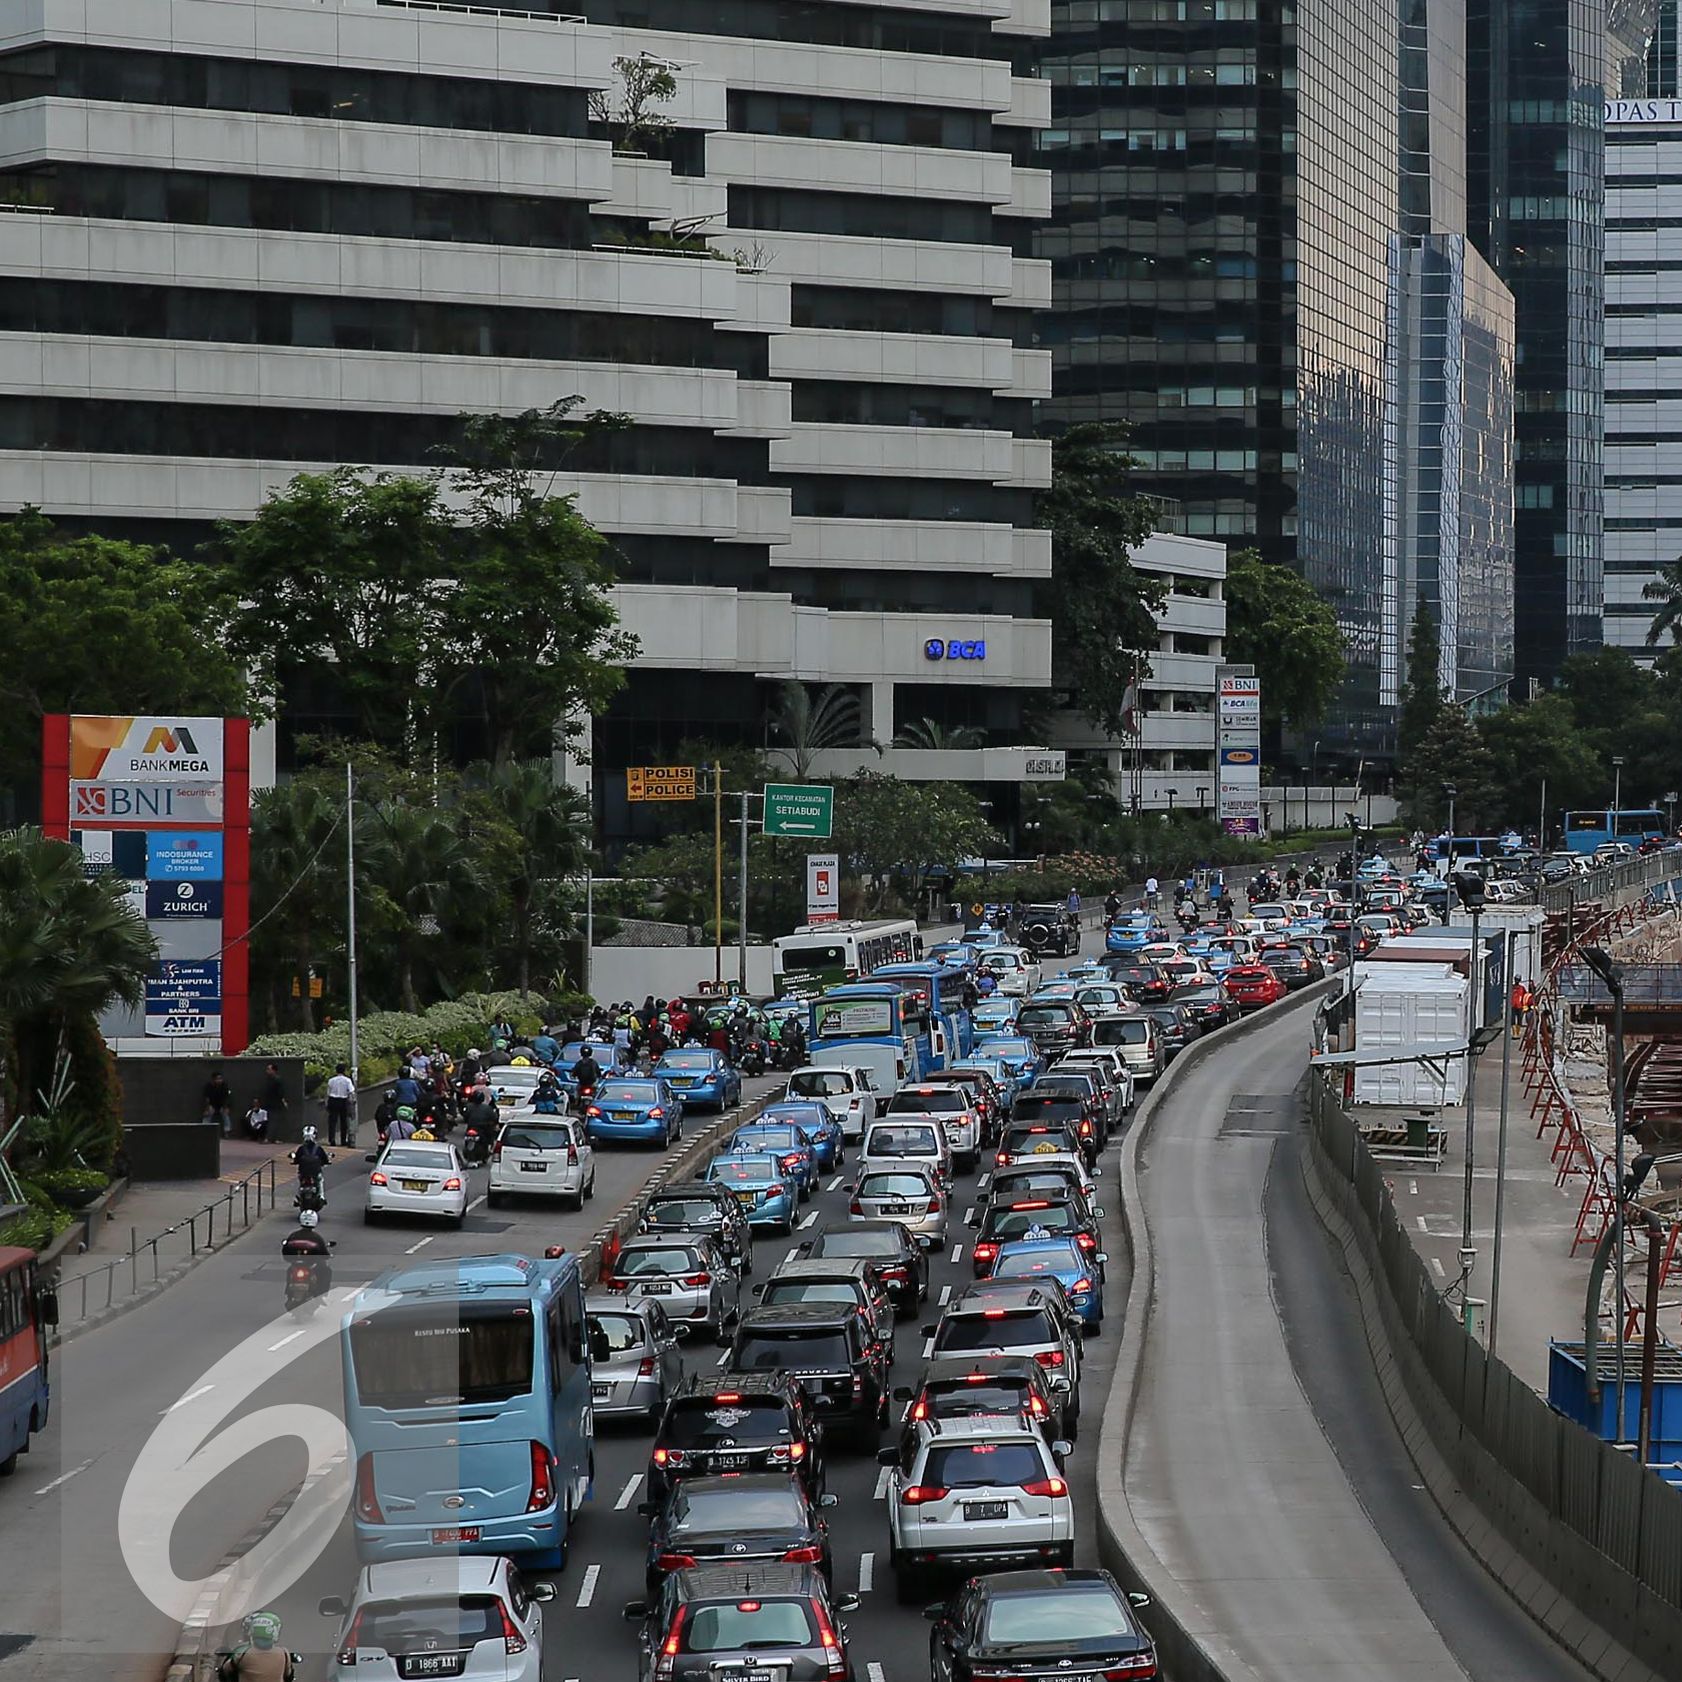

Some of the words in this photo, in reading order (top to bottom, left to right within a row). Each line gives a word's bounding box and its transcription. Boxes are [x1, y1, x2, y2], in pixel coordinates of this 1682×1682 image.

[947, 640, 986, 660] BCA
[1235, 680, 1256, 690] BNI
[646, 768, 694, 779] POLISI
[646, 785, 694, 795] POLICE
[111, 787, 174, 816] BNI
[176, 788, 216, 797] Securities
[771, 794, 794, 802] KANTOR
[795, 795, 826, 804] KECAMATAN
[775, 805, 821, 816] SETIABUDI
[83, 851, 111, 863] HSC
[156, 850, 214, 859] INDOSURANCE
[163, 902, 208, 912] ZURICH
[163, 1016, 206, 1028] ATM
[965, 1505, 970, 1515] B
[980, 1504, 985, 1514] 7
[419, 1658, 438, 1670] 1866
